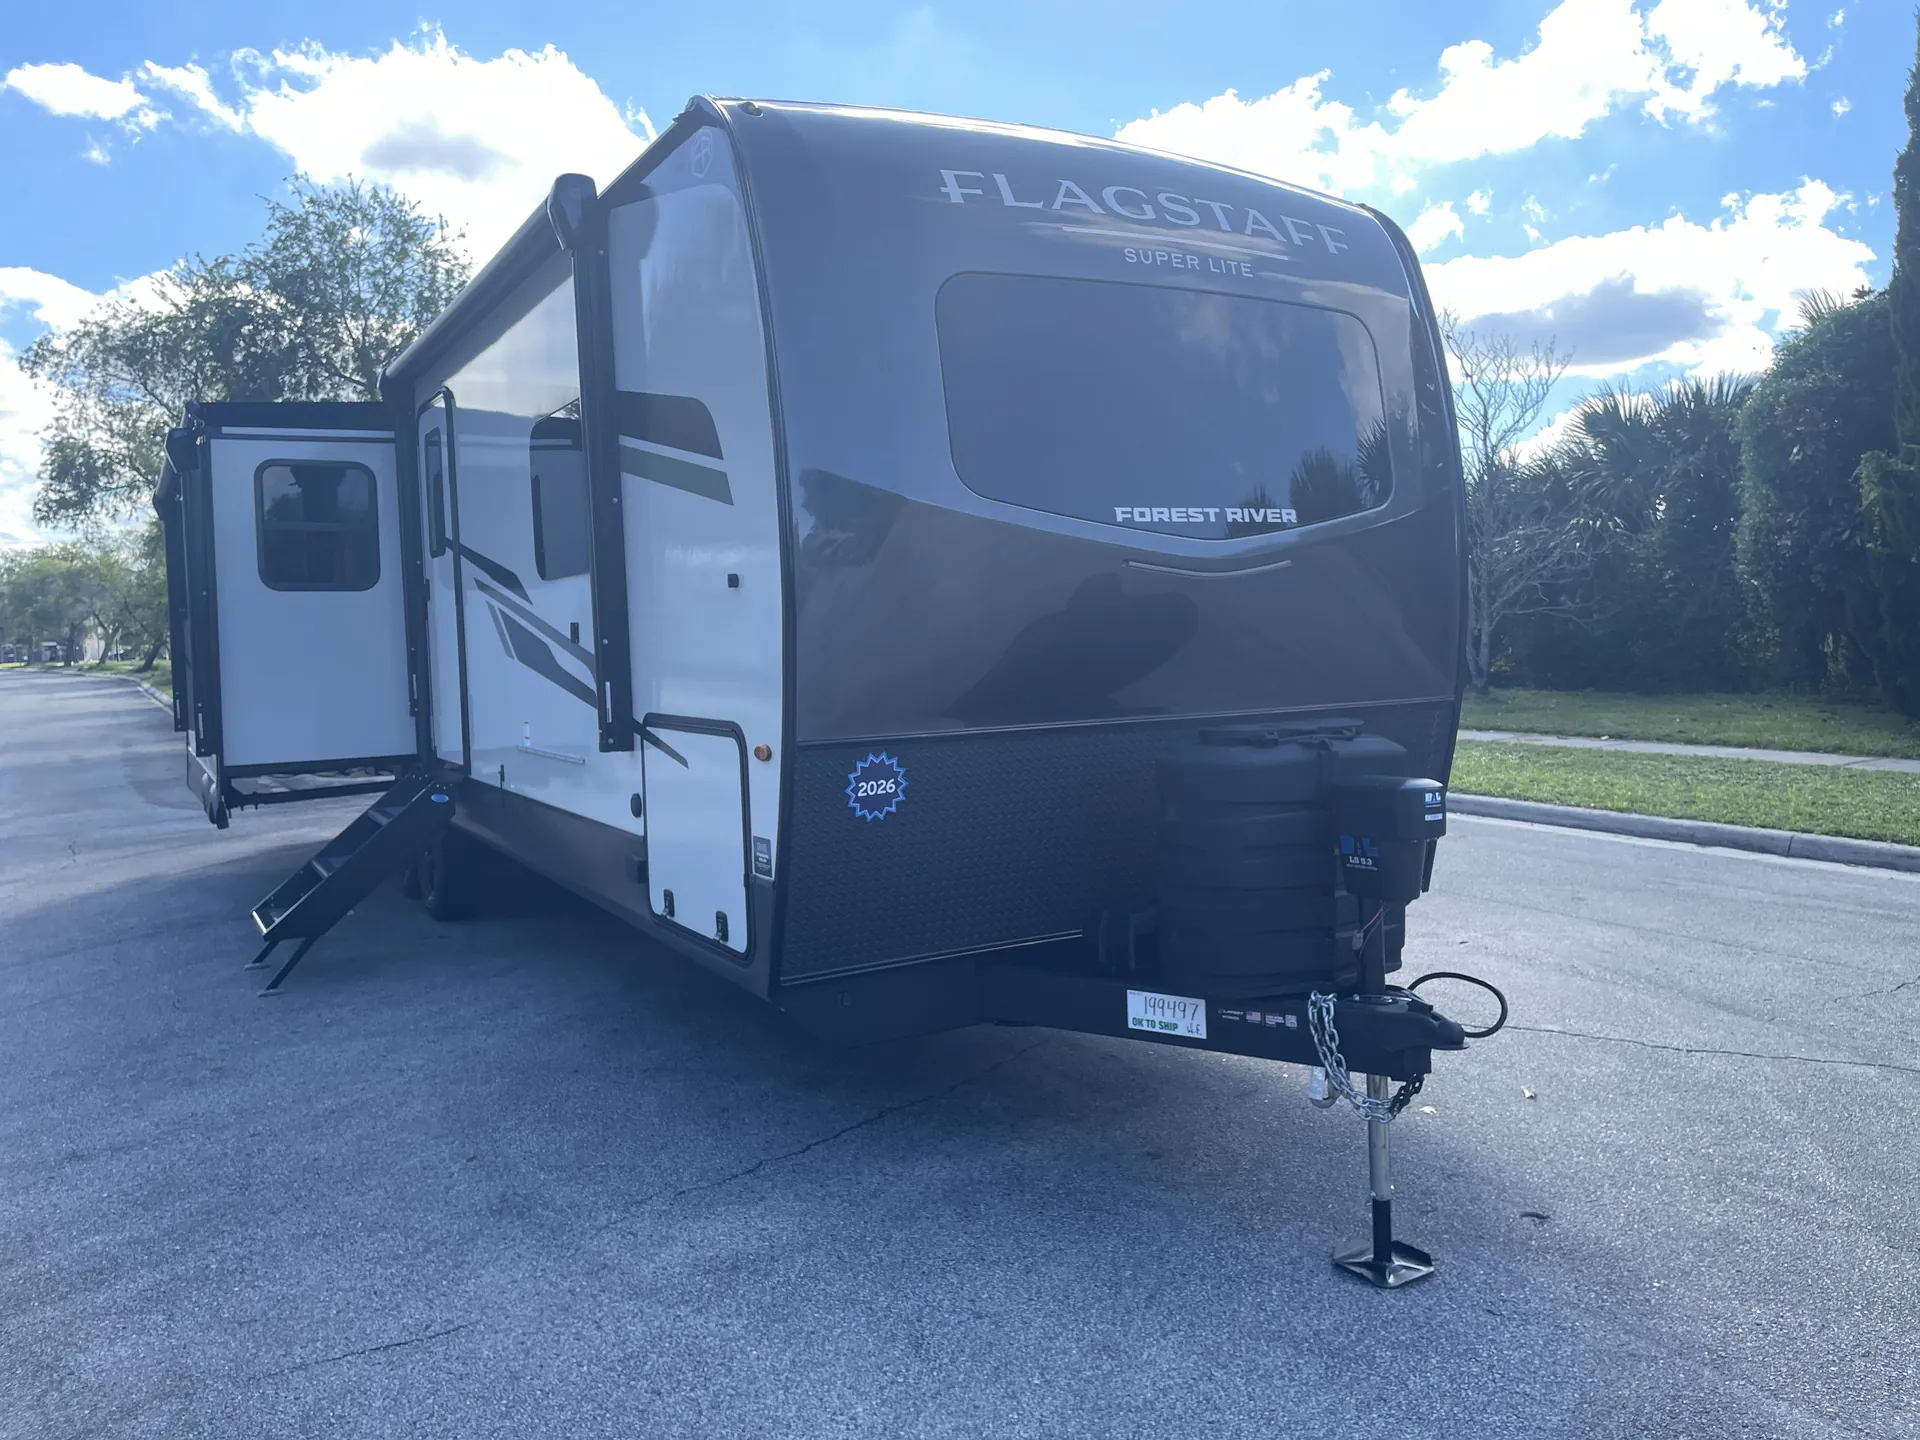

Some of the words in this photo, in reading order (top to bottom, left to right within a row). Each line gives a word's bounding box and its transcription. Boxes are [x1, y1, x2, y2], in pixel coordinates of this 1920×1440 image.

[940, 169, 1348, 255] FLAGSTAFF
[1124, 248, 1200, 270] SUPER
[1209, 258, 1254, 277] LITE
[1114, 507, 1220, 523] FOREST
[1225, 508, 1298, 523] RIVER
[857, 778, 896, 797] 2026
[1144, 996, 1199, 1021] 199497
[1132, 1017, 1144, 1028] OK
[1145, 1018, 1156, 1029] TO
[1158, 1020, 1179, 1032] SHIP
